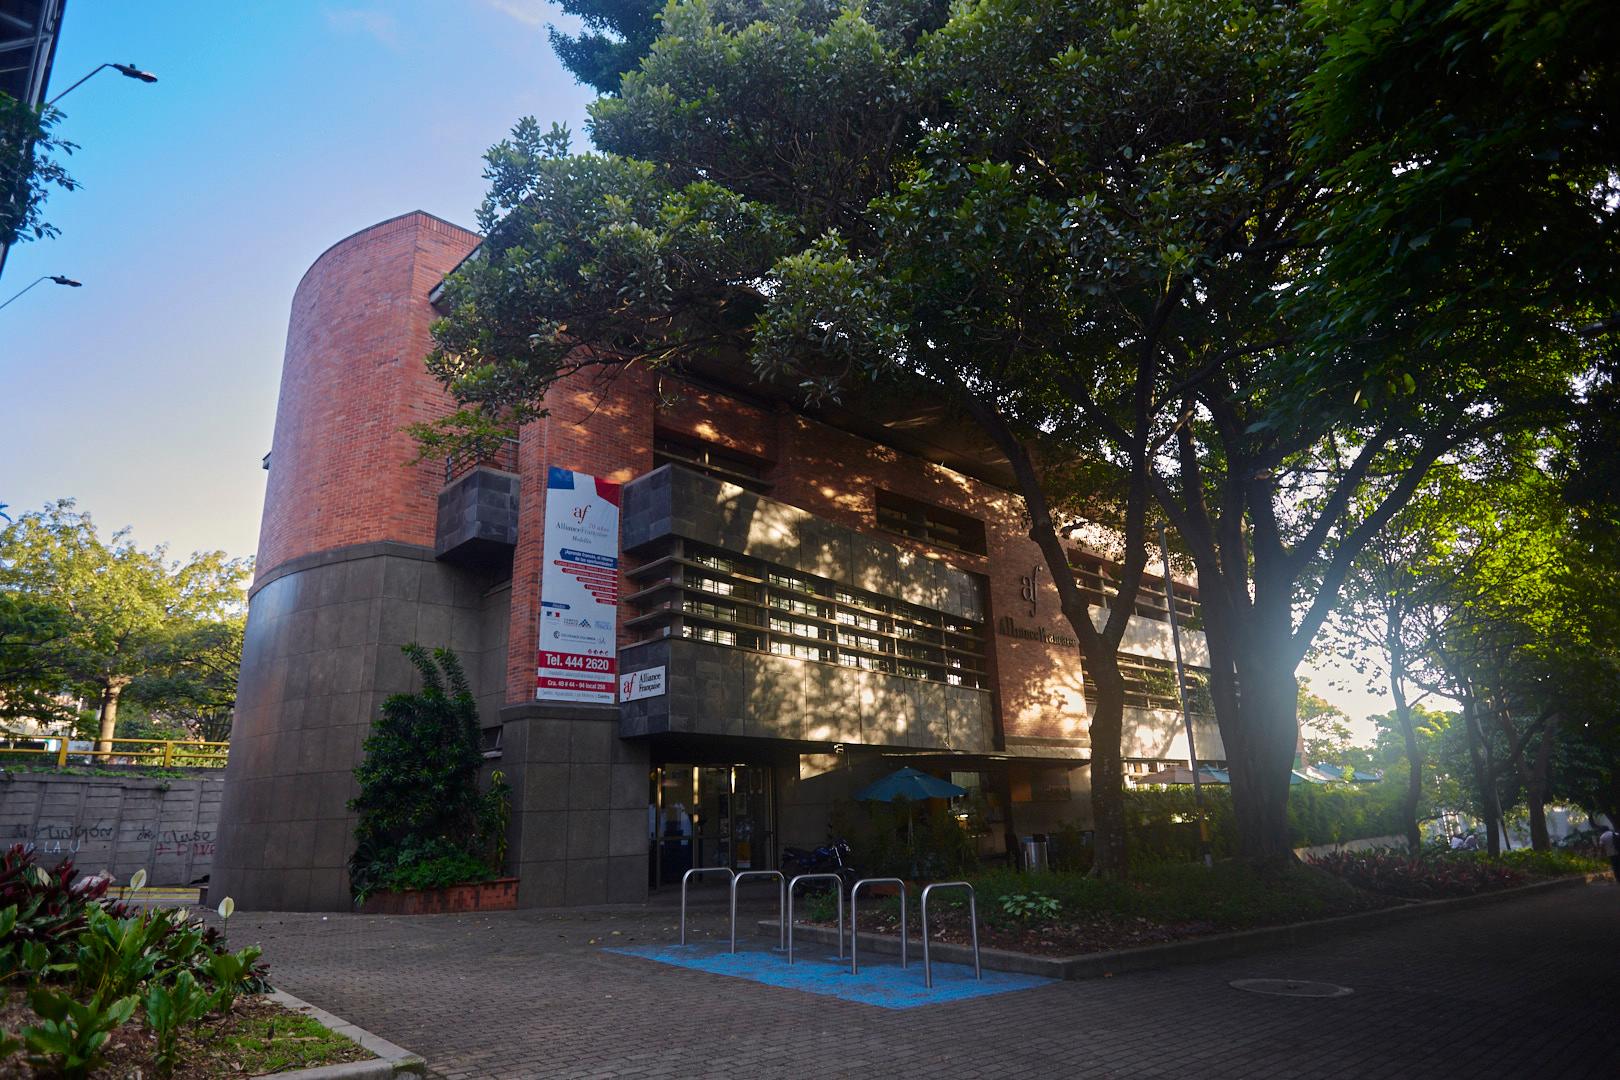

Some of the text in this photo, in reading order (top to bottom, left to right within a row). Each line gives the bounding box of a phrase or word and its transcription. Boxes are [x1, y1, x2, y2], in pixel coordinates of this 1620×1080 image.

[573, 504, 592, 525] af
[1021, 565, 1041, 617] af
[545, 653, 609, 671] Tel. 444 2620
[623, 672, 637, 701] af
[639, 673, 662, 683] Alliance
[638, 682, 661, 693] Française
[44, 840, 61, 853] LA
[69, 839, 81, 854] U
